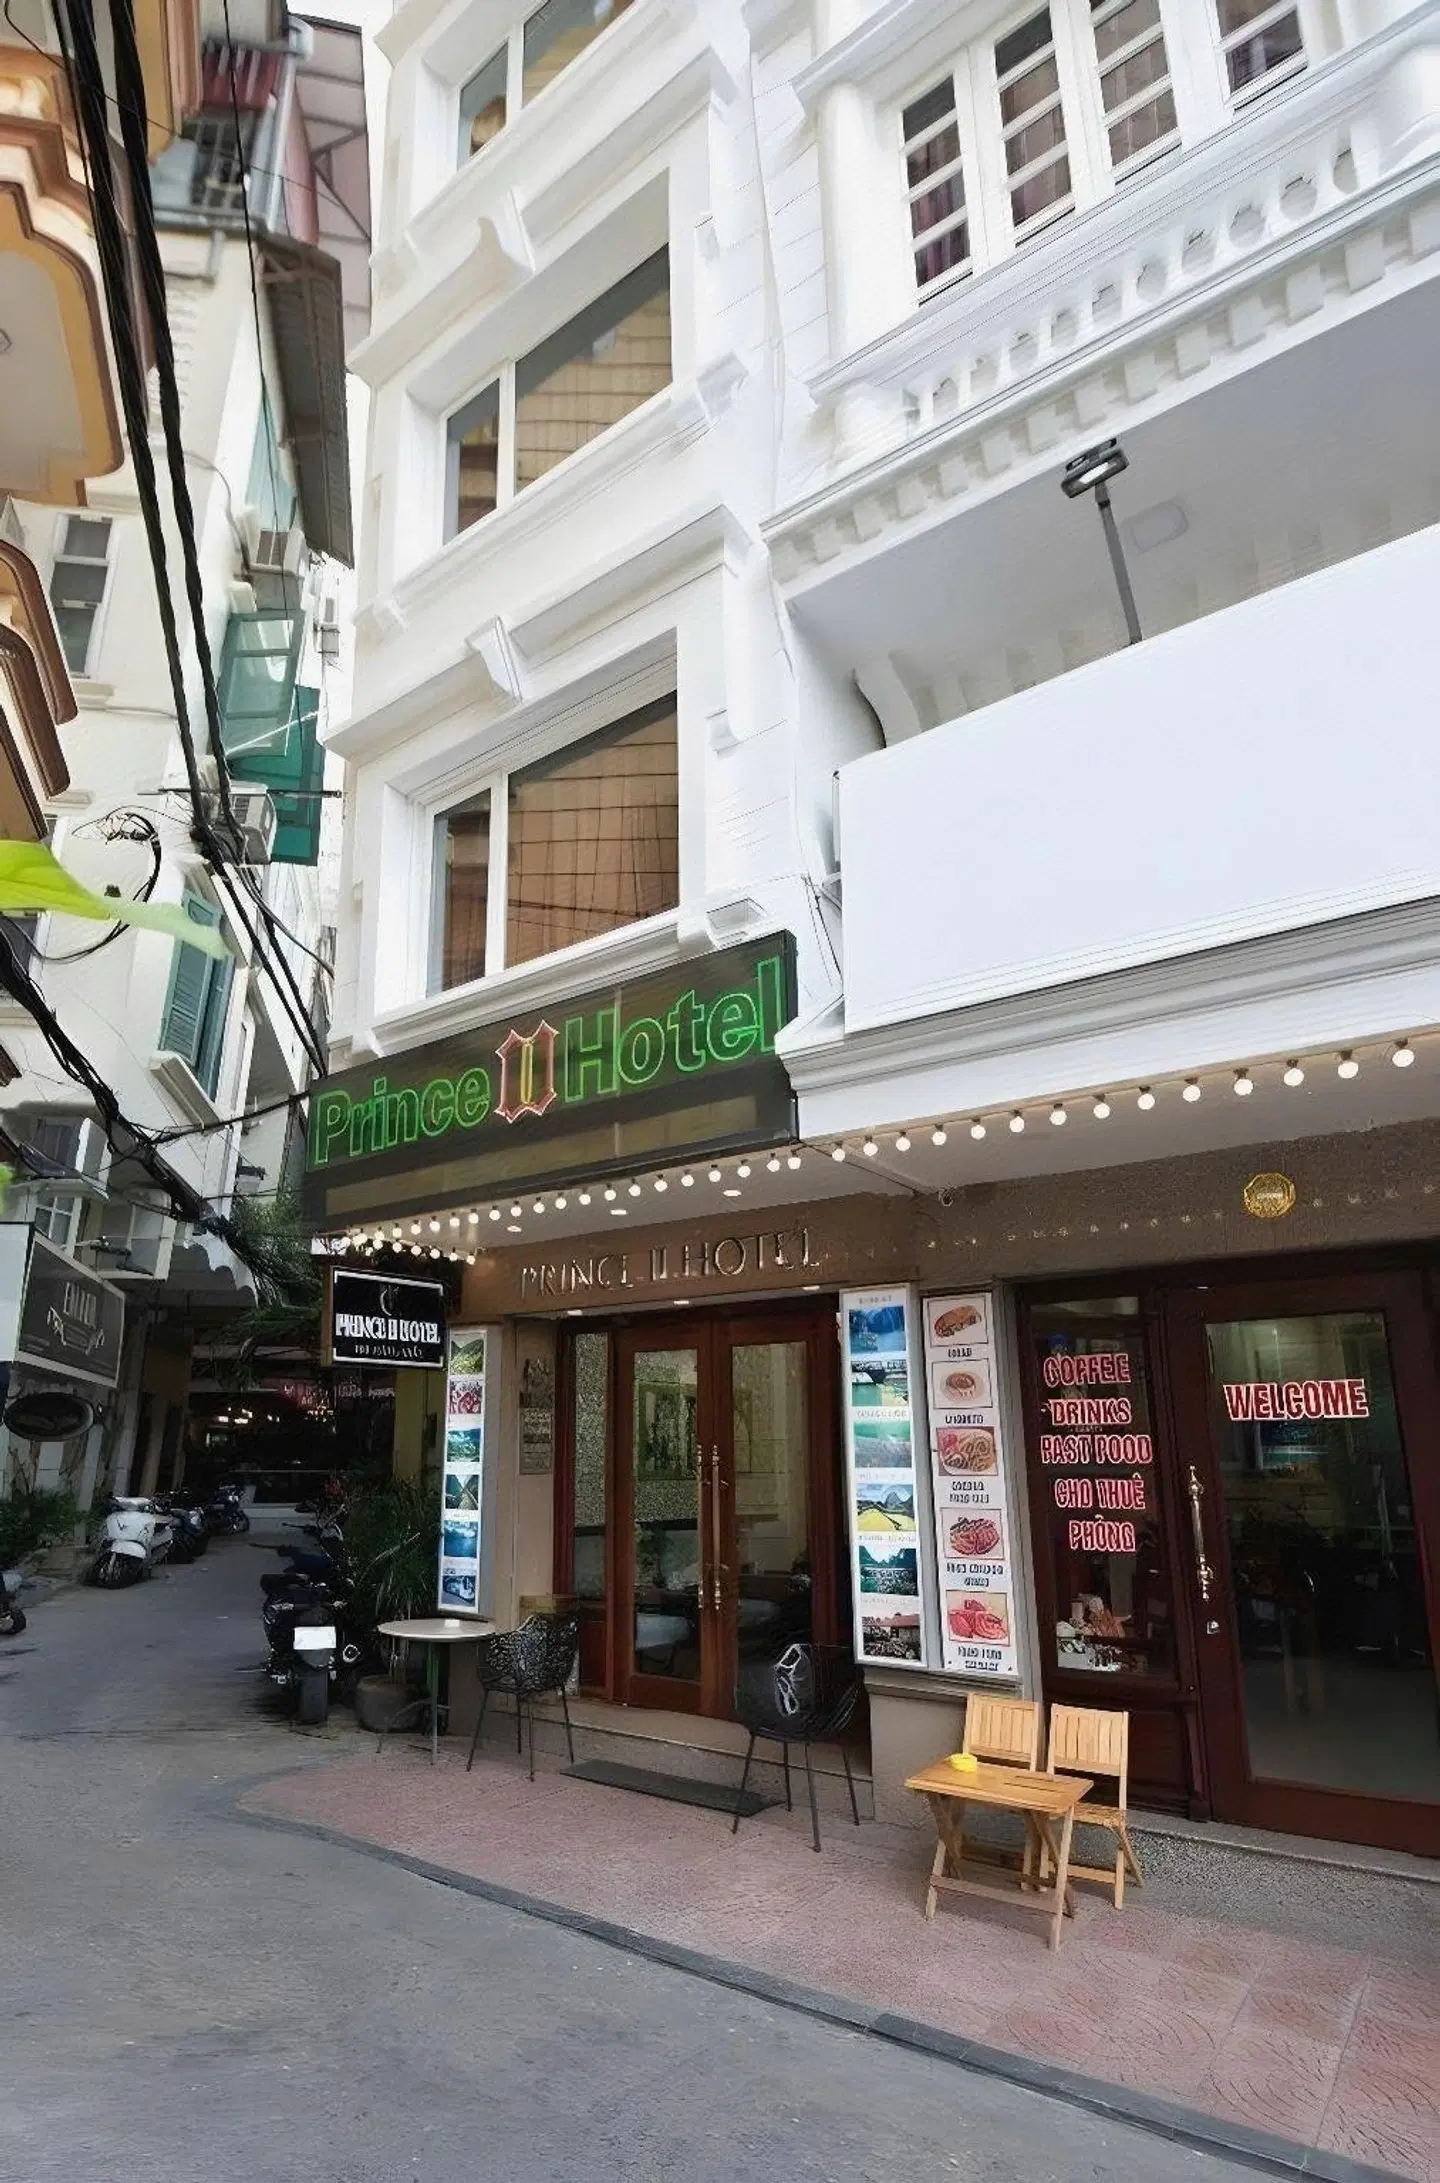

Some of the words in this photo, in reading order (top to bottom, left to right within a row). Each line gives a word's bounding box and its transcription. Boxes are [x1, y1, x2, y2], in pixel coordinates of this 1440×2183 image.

[311, 1066, 491, 1166] Prince
[564, 955, 784, 1103] Hotel
[1048, 1397, 1133, 1426] DRINKS
[1222, 1378, 1370, 1421] WELCOME
